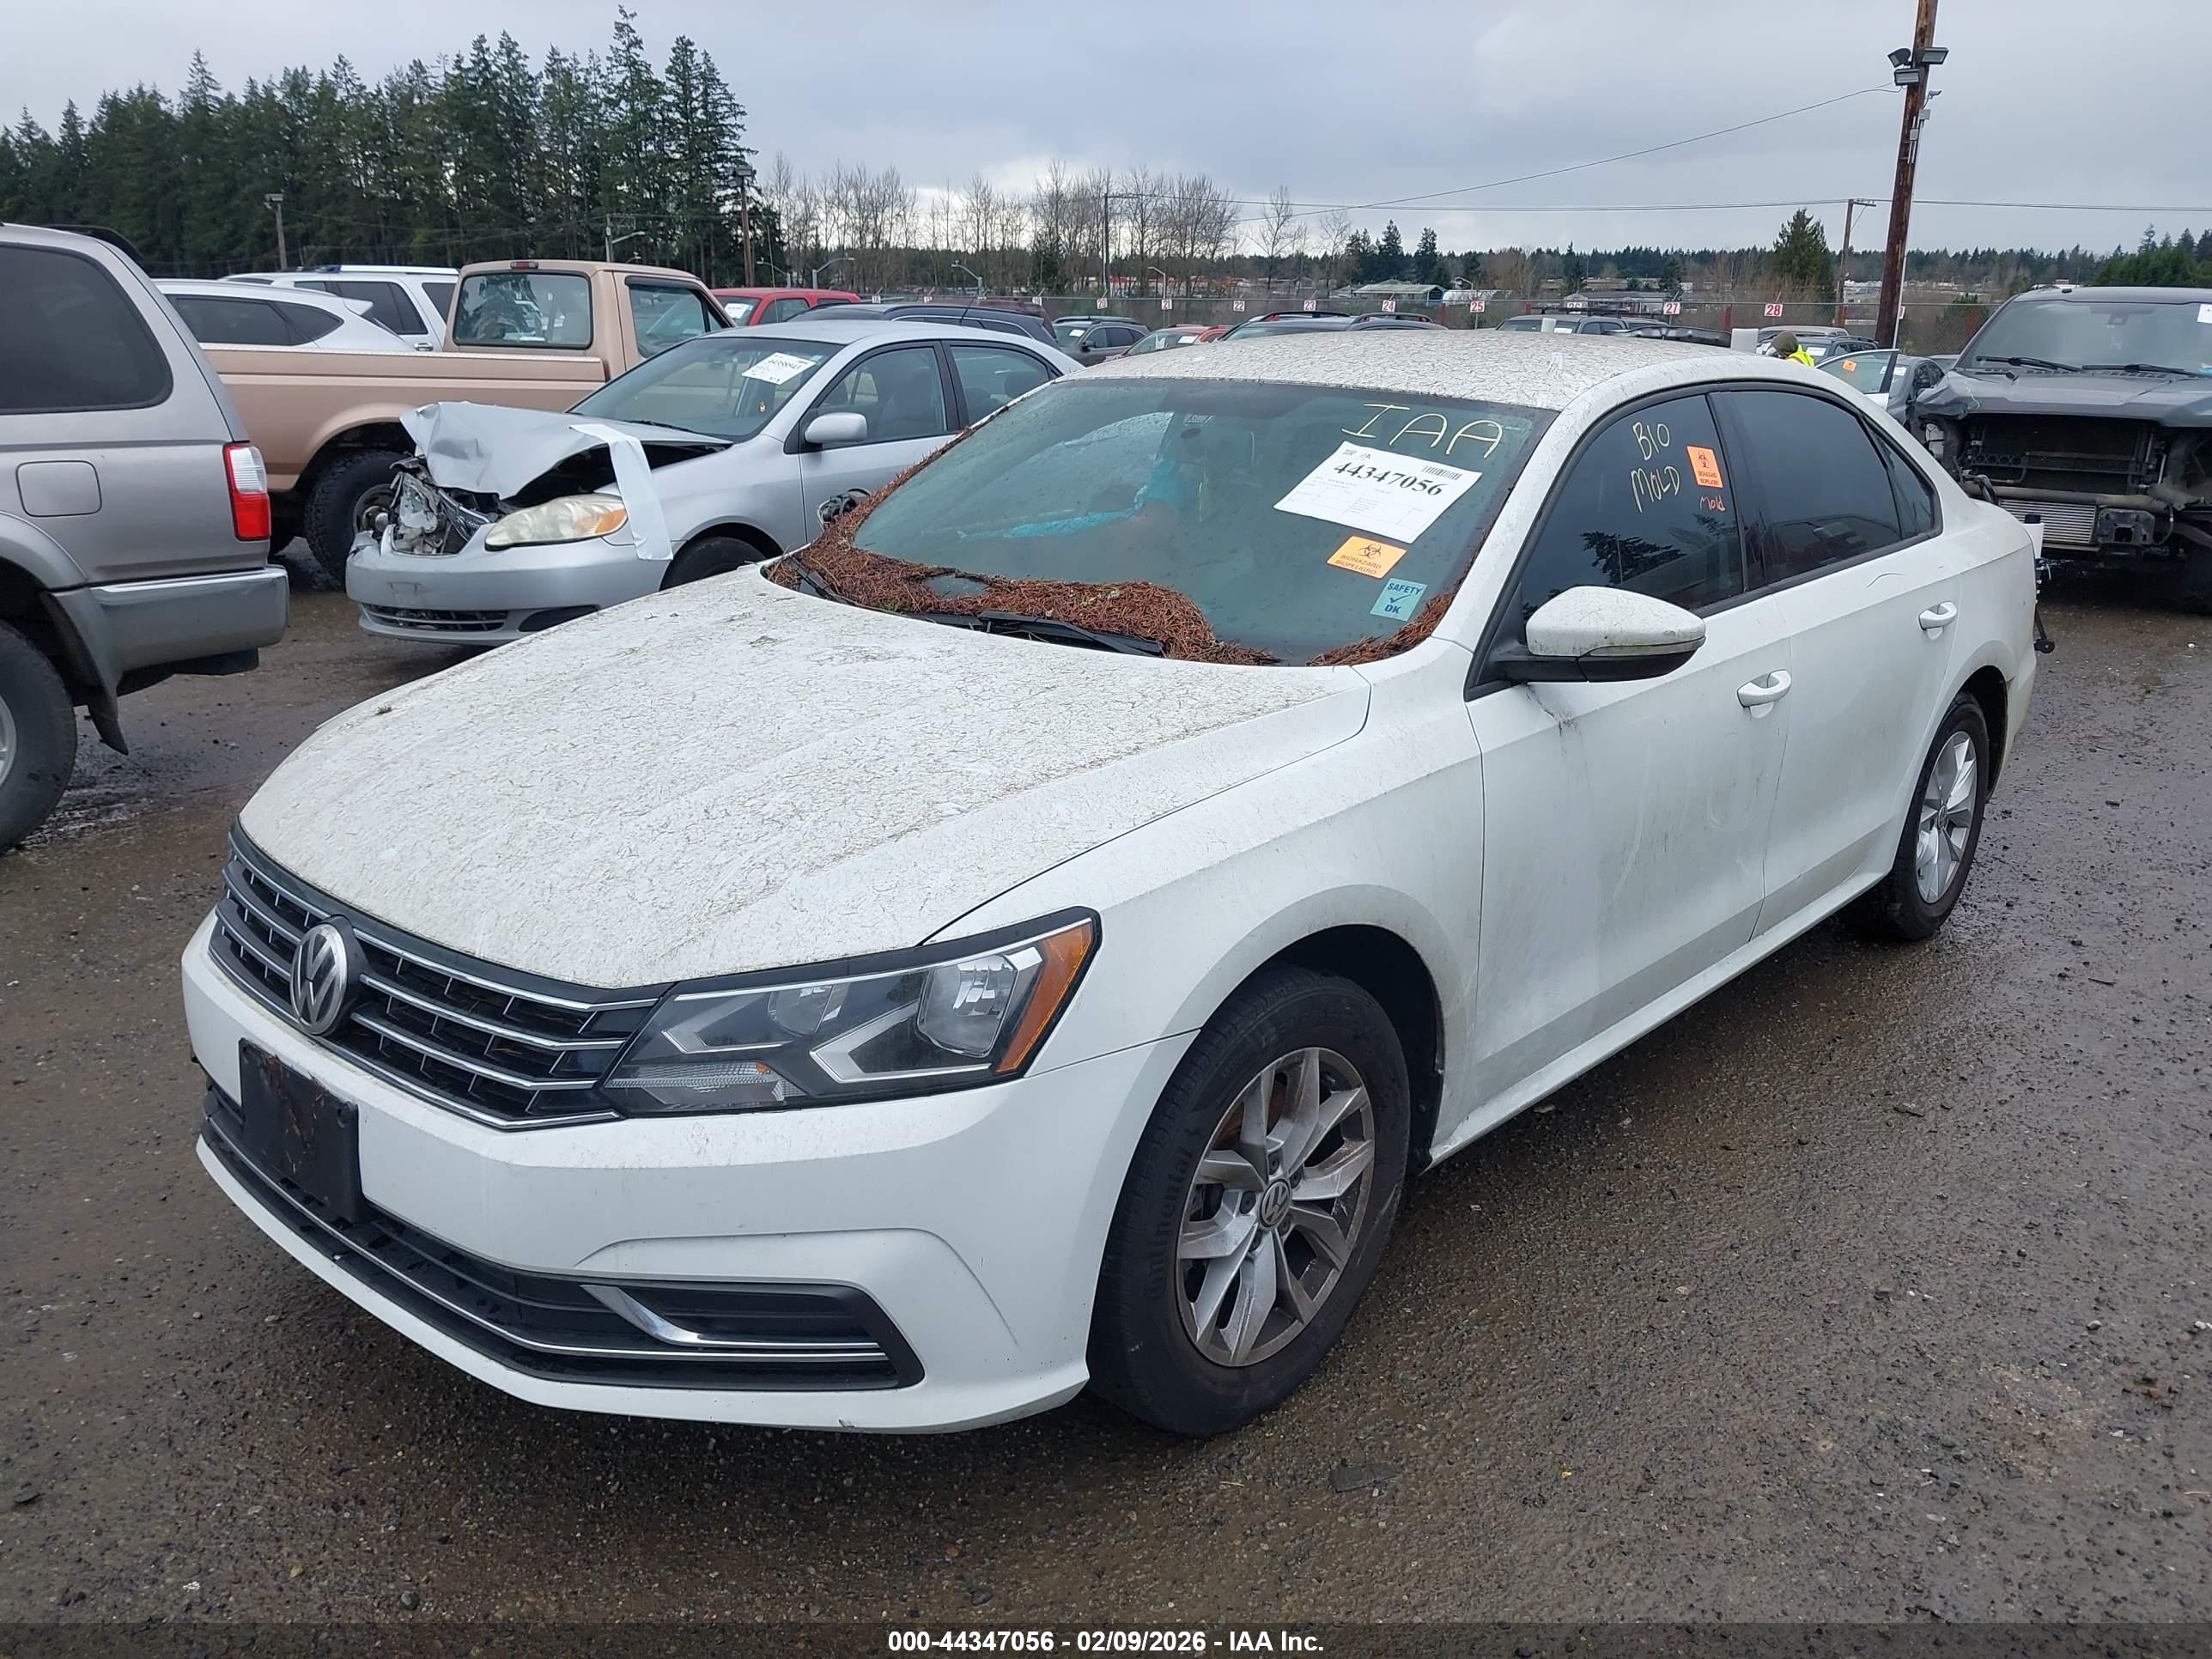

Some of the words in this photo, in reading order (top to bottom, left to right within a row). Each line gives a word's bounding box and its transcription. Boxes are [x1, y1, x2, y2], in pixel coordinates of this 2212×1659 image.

[1097, 299, 1106, 308] 20
[1163, 300, 1171, 309] 21
[1234, 301, 1244, 310] 22
[1304, 301, 1316, 310] 23
[1383, 301, 1395, 311] 24
[1471, 301, 1484, 312] 25
[1665, 303, 1678, 314] 27
[1766, 305, 1781, 315] 28
[1341, 404, 1504, 459] IAA
[1632, 422, 1670, 461] BIO
[1334, 462, 1449, 495] 44347056
[1630, 465, 1680, 514] MOLD
[1334, 559, 1377, 574] BIOPELIGRO
[1340, 555, 1382, 569] BIOHAZARD
[1387, 582, 1423, 595] SAFETY
[1384, 604, 1401, 614] OK
